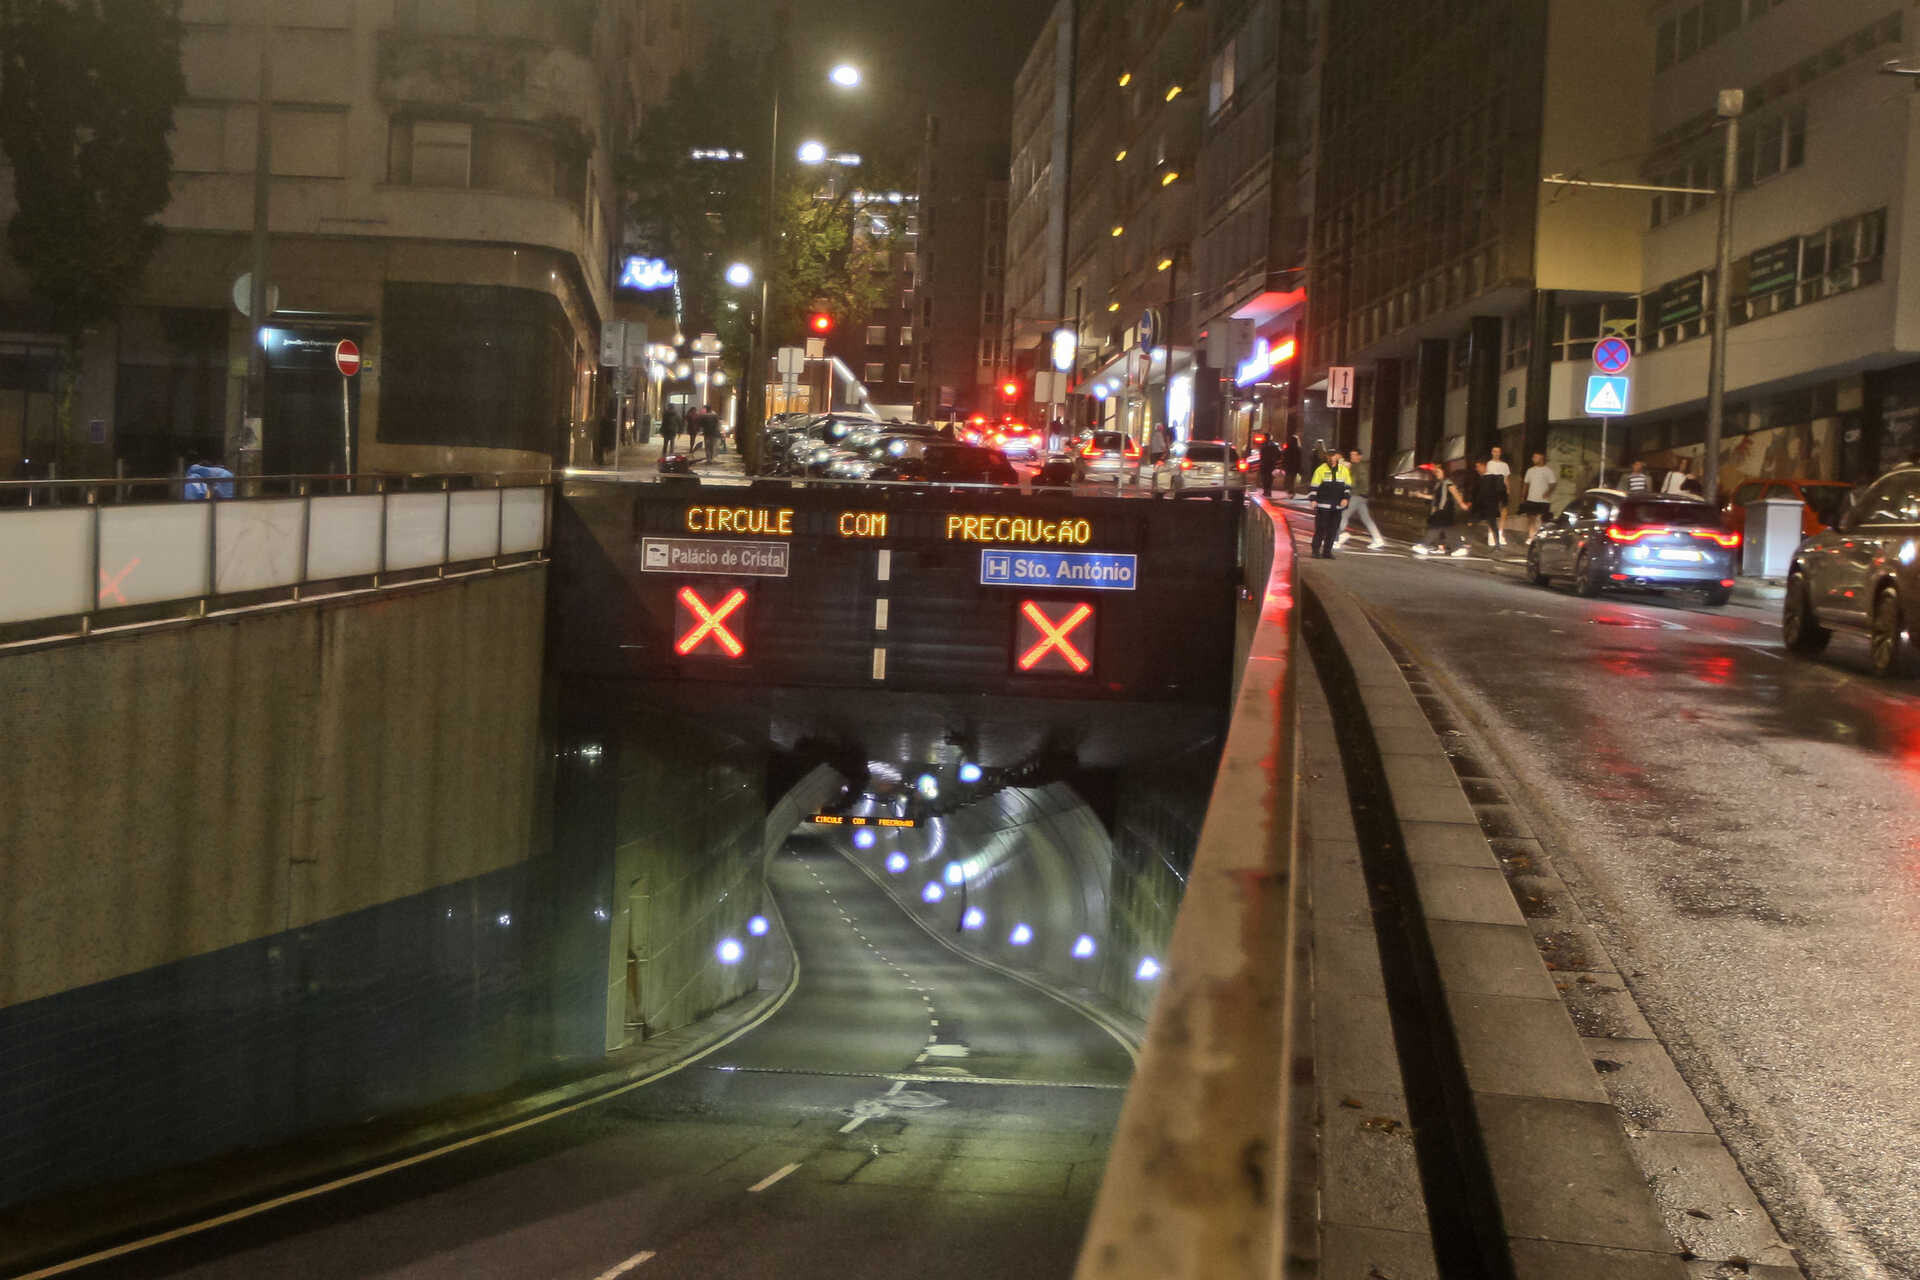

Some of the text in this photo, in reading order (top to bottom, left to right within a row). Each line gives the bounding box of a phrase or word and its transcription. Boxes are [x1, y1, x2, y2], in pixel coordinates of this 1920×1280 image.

[687, 507, 794, 534] CIRCULE
[839, 512, 888, 537] COM
[671, 546, 786, 569] Palácio de Cristal
[1014, 559, 1050, 578] Sto.
[1056, 560, 1131, 581] António
